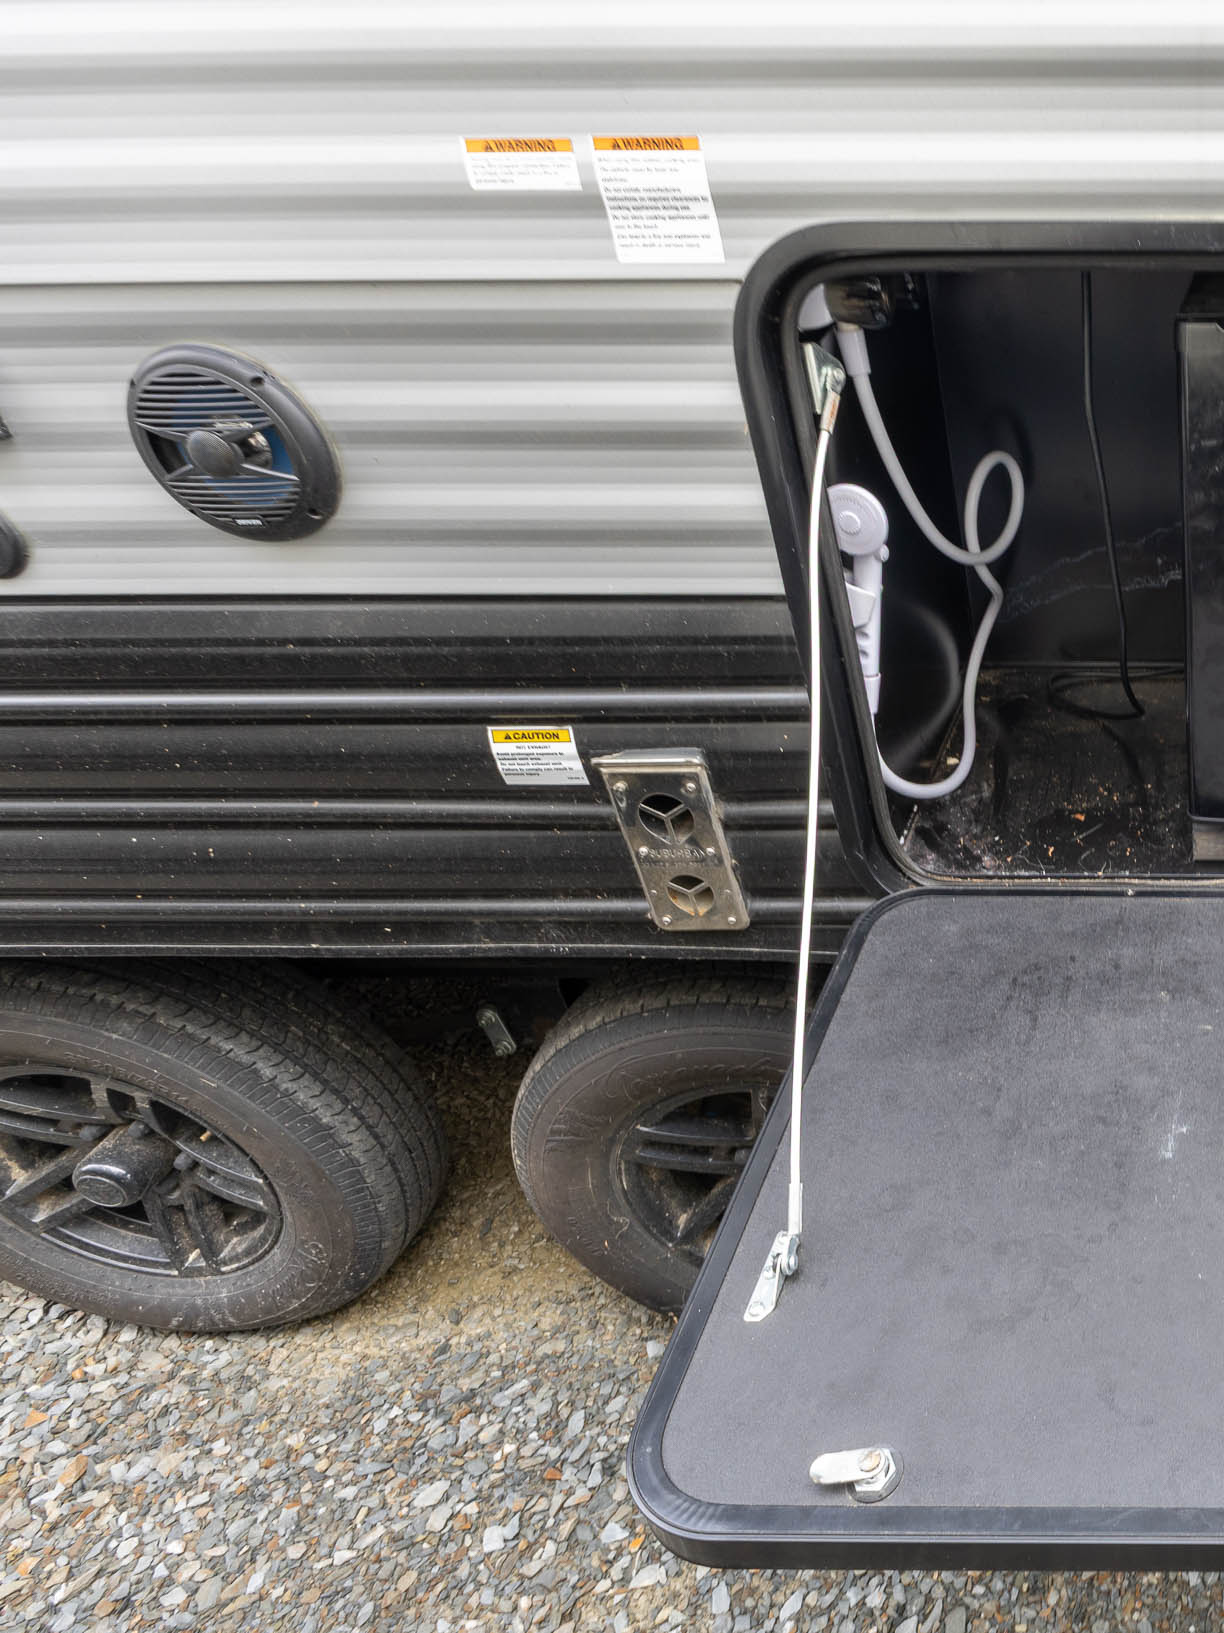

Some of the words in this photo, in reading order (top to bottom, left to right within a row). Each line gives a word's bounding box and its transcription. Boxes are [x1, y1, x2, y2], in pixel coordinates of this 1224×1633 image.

[494, 139, 557, 152] WARNING
[623, 137, 685, 151] WARNING
[513, 732, 560, 740] CAUTION
[649, 848, 706, 859] SUBURBAN
